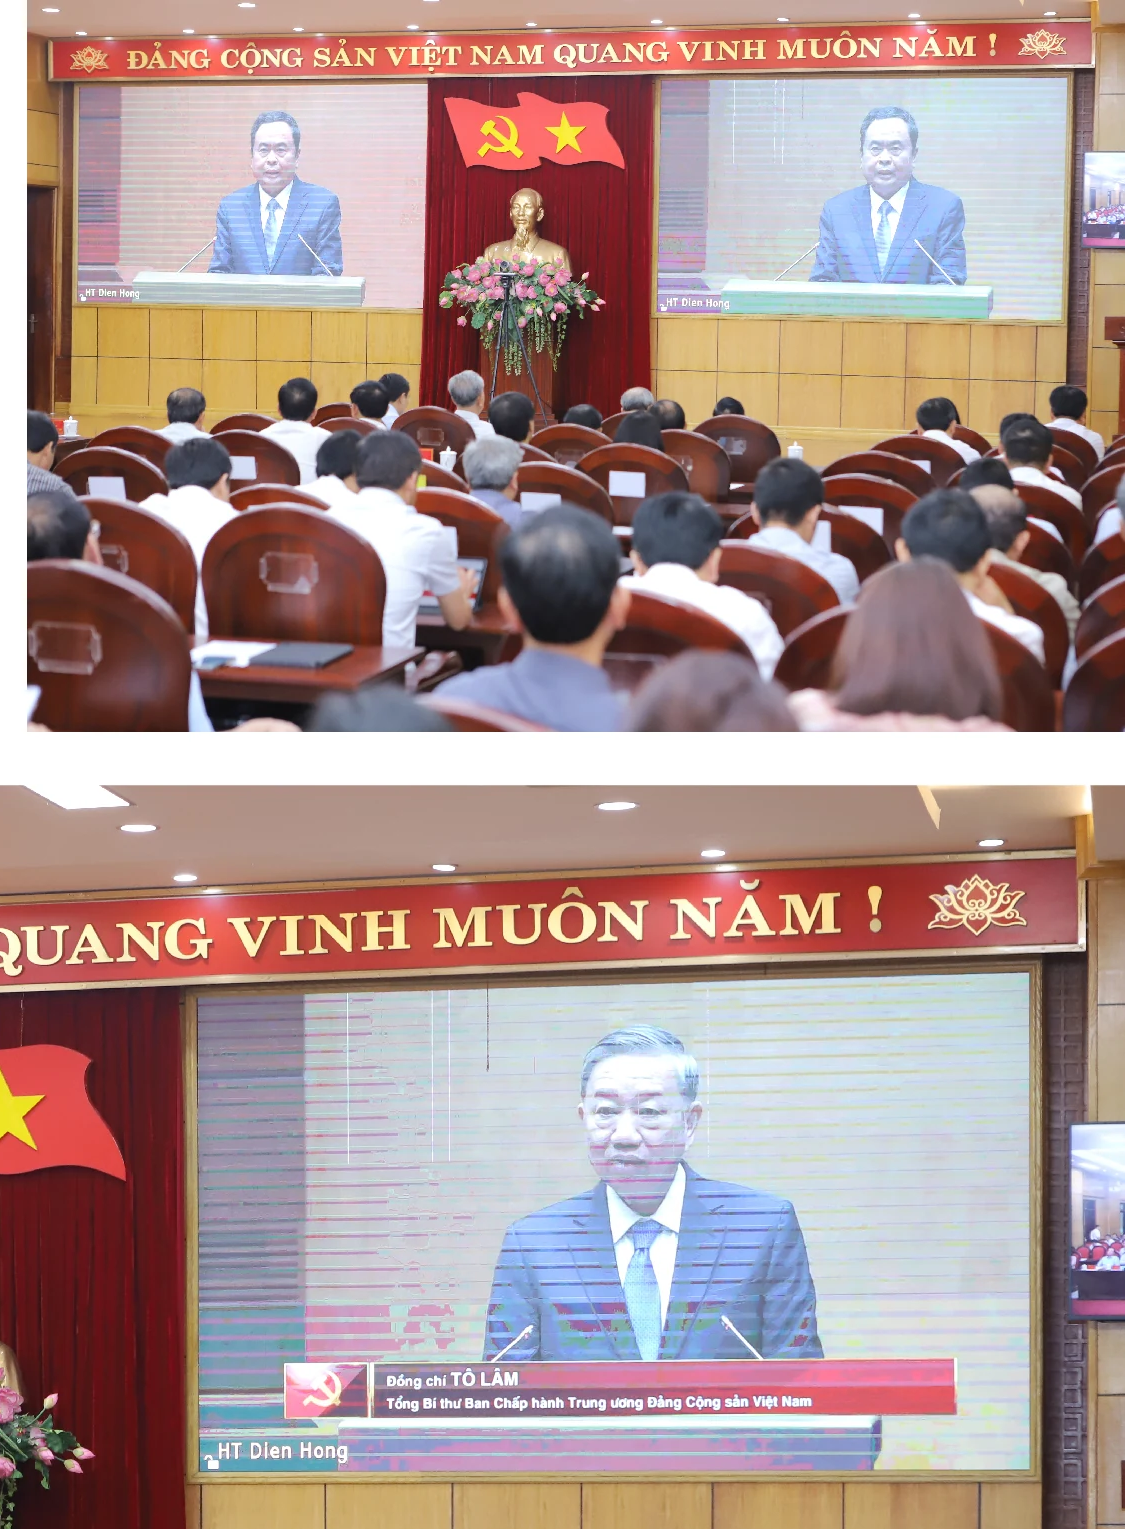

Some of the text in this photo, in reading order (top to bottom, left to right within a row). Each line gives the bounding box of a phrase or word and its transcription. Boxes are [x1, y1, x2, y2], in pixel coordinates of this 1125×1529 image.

[127, 29, 997, 74] ĐẢNG CỘNG SẢN VIỆT NAM QUANG VINH MUÔN NĂM !
[85, 289, 96, 297] HT
[120, 289, 140, 299] Hong
[666, 298, 730, 310] HT Dien Hong
[228, 910, 411, 958] VINH
[433, 887, 649, 949] MUÔN
[670, 878, 841, 940] NĂM
[867, 886, 883, 933] !
[386, 1368, 519, 1389] Đồng chí TÔ LÂM
[386, 1393, 812, 1412] Tổng Bí thư Ban Chấp hành Trung ương Đảng Cộng sản Việt Nam
[218, 1442, 348, 1463] HT Dien Hong
